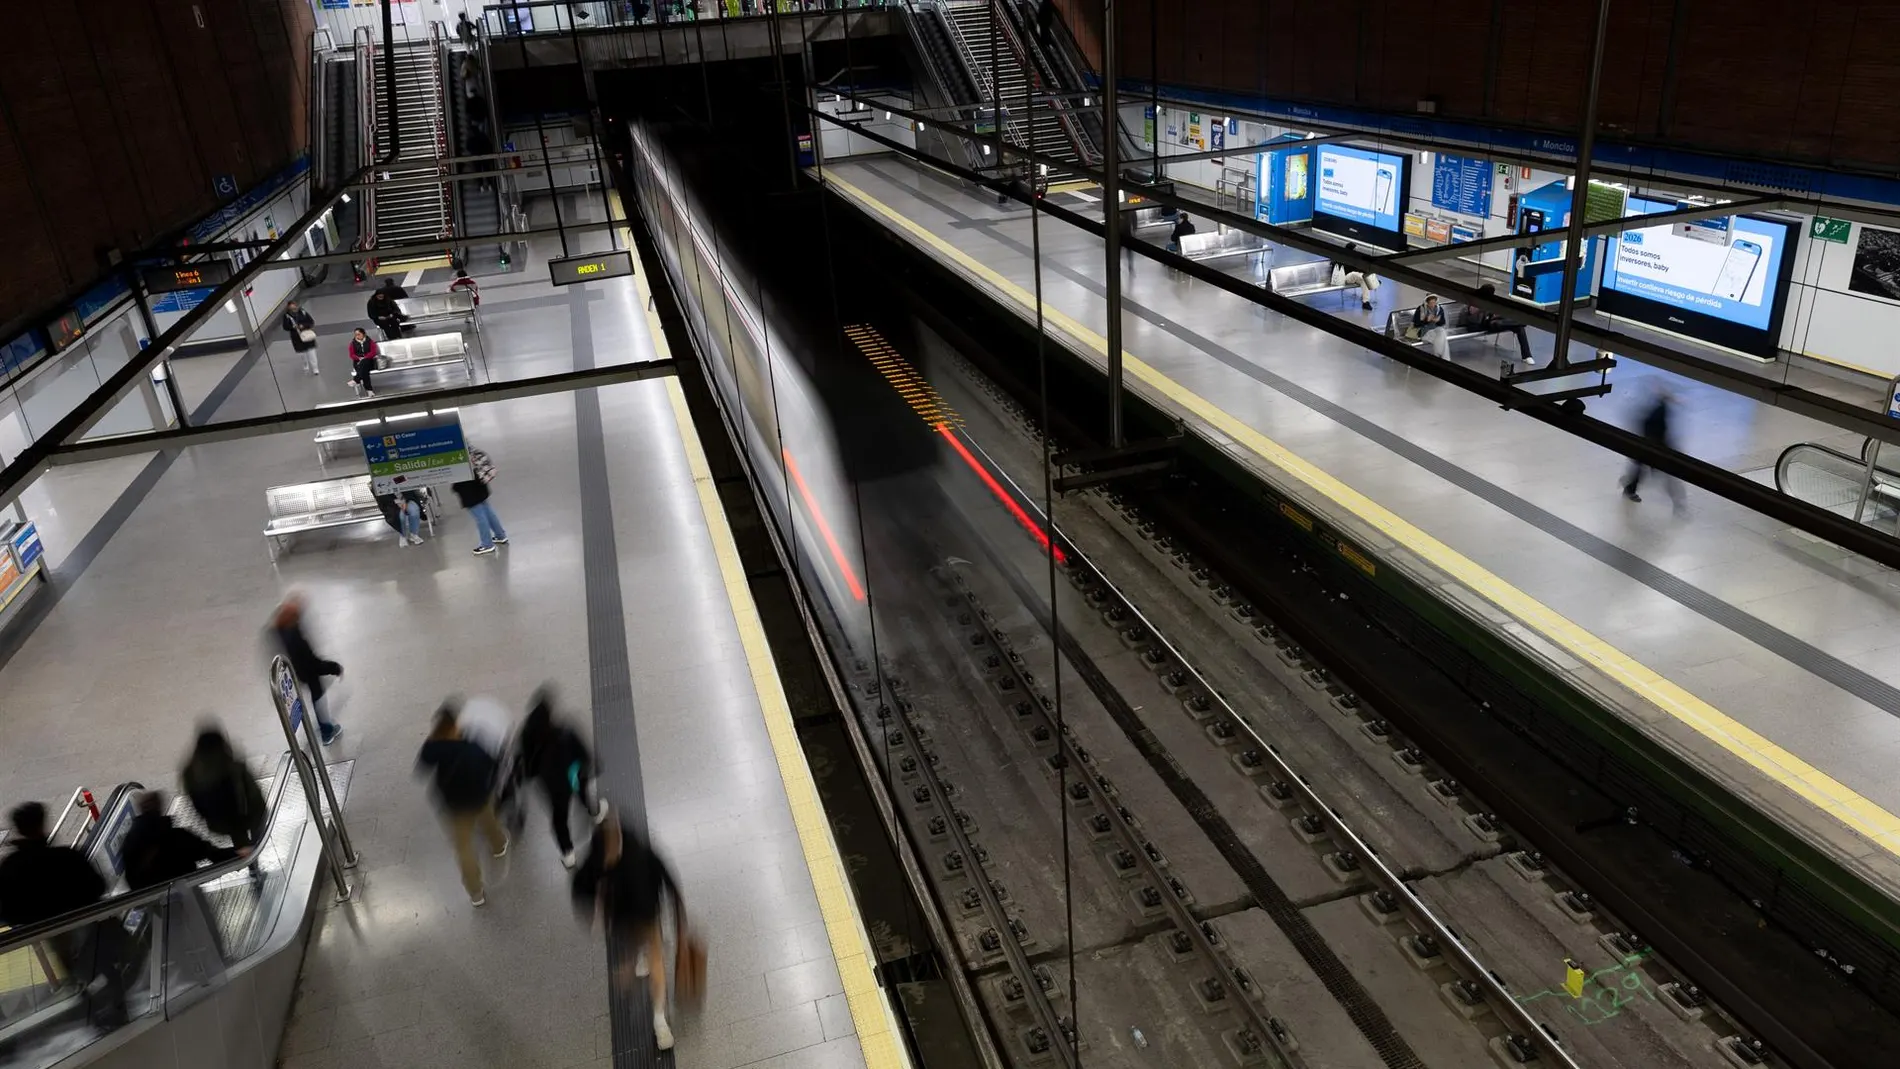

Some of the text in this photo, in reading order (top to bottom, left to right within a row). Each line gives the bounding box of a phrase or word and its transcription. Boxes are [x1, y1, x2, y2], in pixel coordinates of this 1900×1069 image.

[1543, 139, 1575, 152] Moncloa
[1624, 233, 1642, 243] 2026
[1622, 245, 1661, 260] Todos somos
[601, 263, 606, 271] 1
[1653, 262, 1669, 273] baby
[394, 460, 427, 472] Salida
